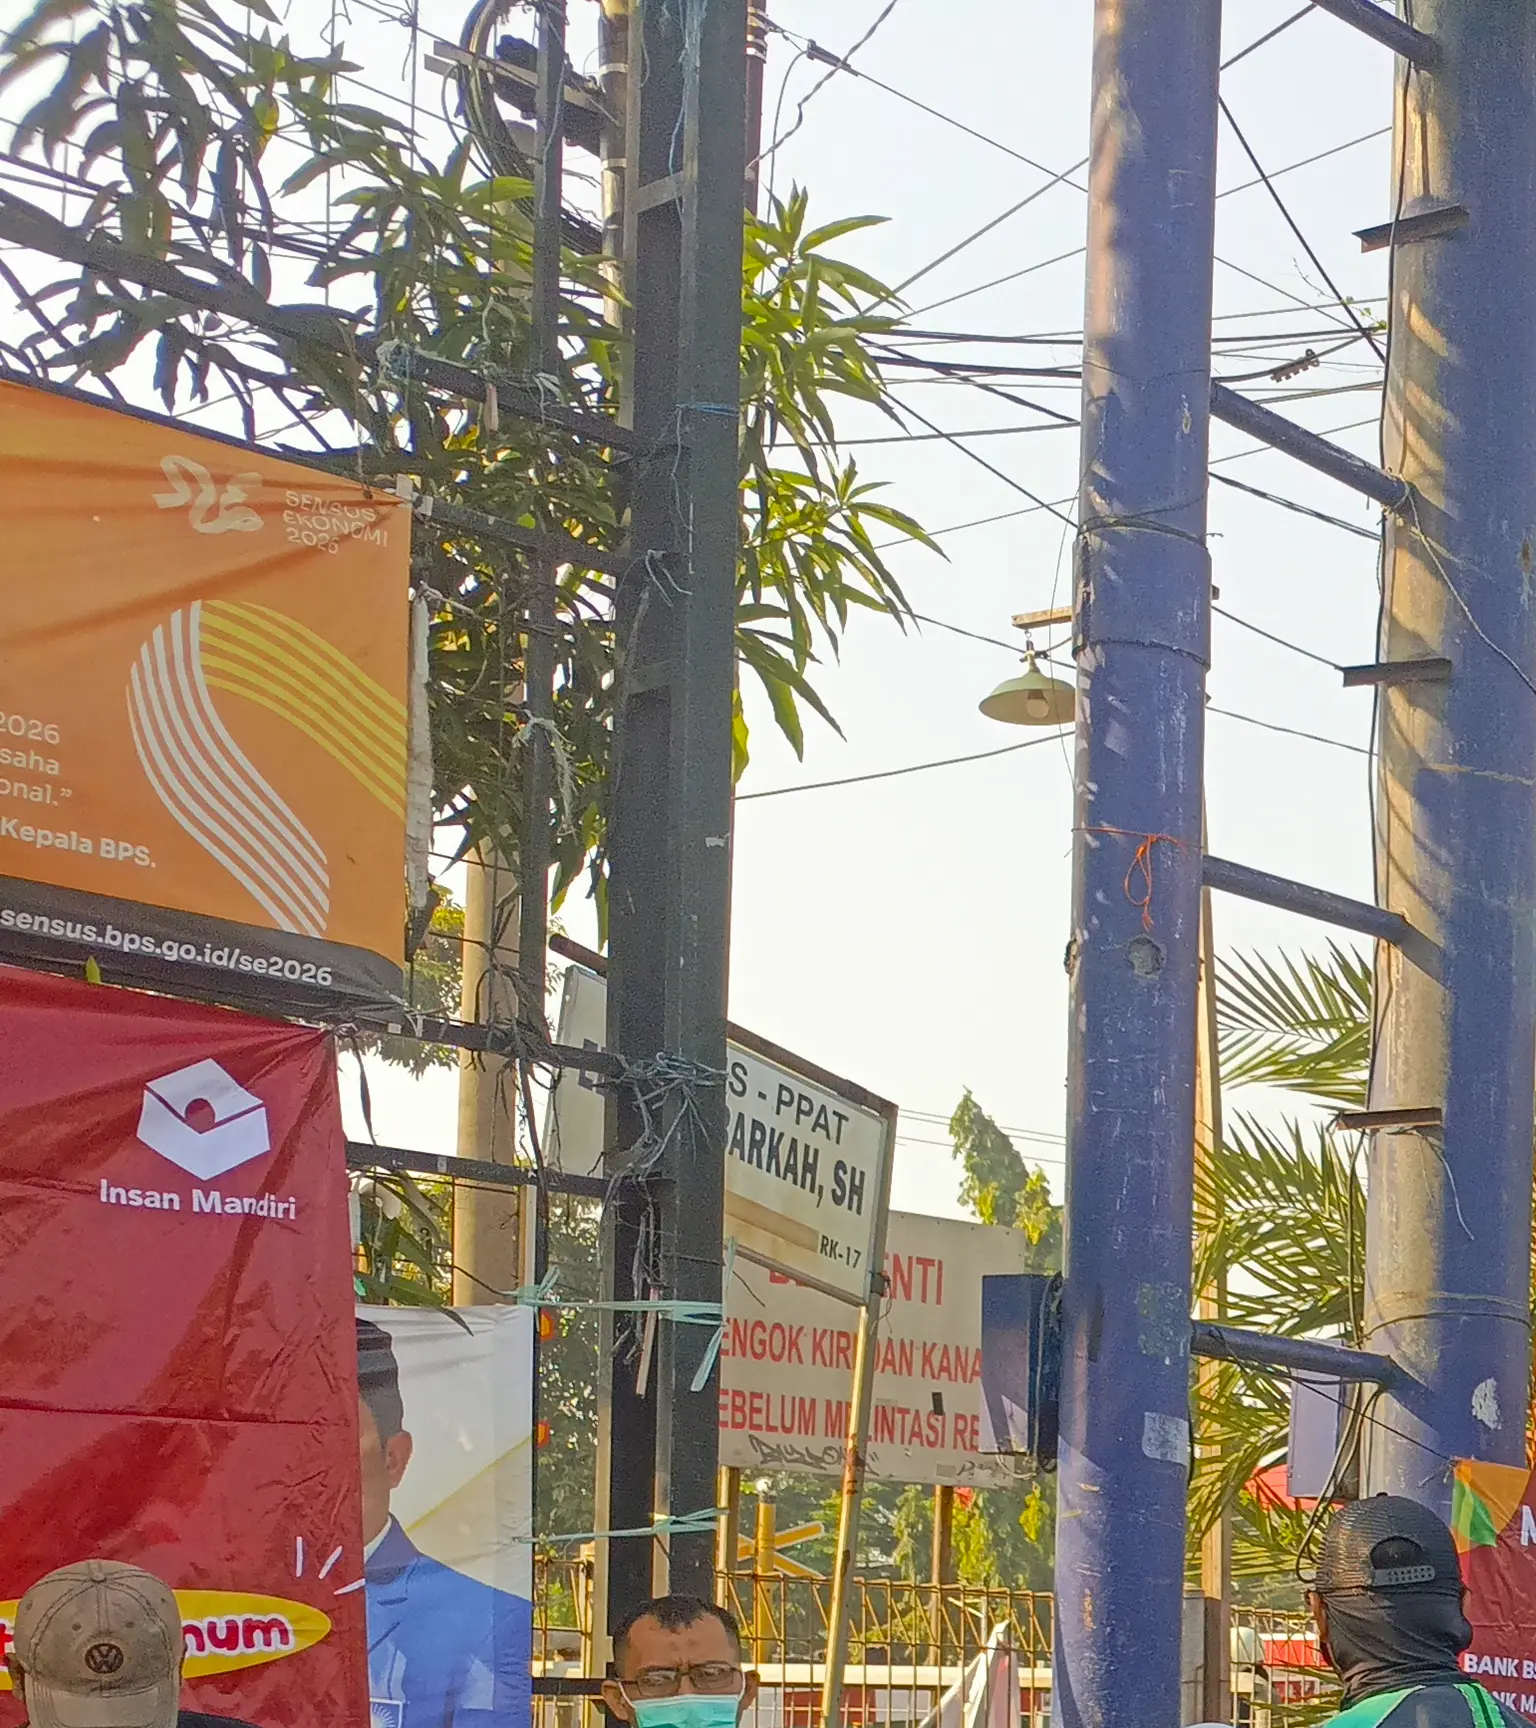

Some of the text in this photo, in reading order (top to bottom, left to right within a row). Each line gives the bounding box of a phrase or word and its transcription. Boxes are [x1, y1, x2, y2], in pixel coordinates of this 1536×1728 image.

[285, 490, 377, 522] SENSUS
[282, 509, 388, 548] EKONOMI
[285, 527, 341, 554] 2026
[0, 815, 157, 868] Kepala BPS.
[0, 906, 334, 987] sensus.bps.go.id/se2026
[775, 1082, 850, 1146] PPAT
[100, 1178, 297, 1220] Insan Mandiri
[831, 1159, 866, 1217] SH
[819, 1234, 863, 1269] RK-17
[1464, 1652, 1519, 1678] BANK
